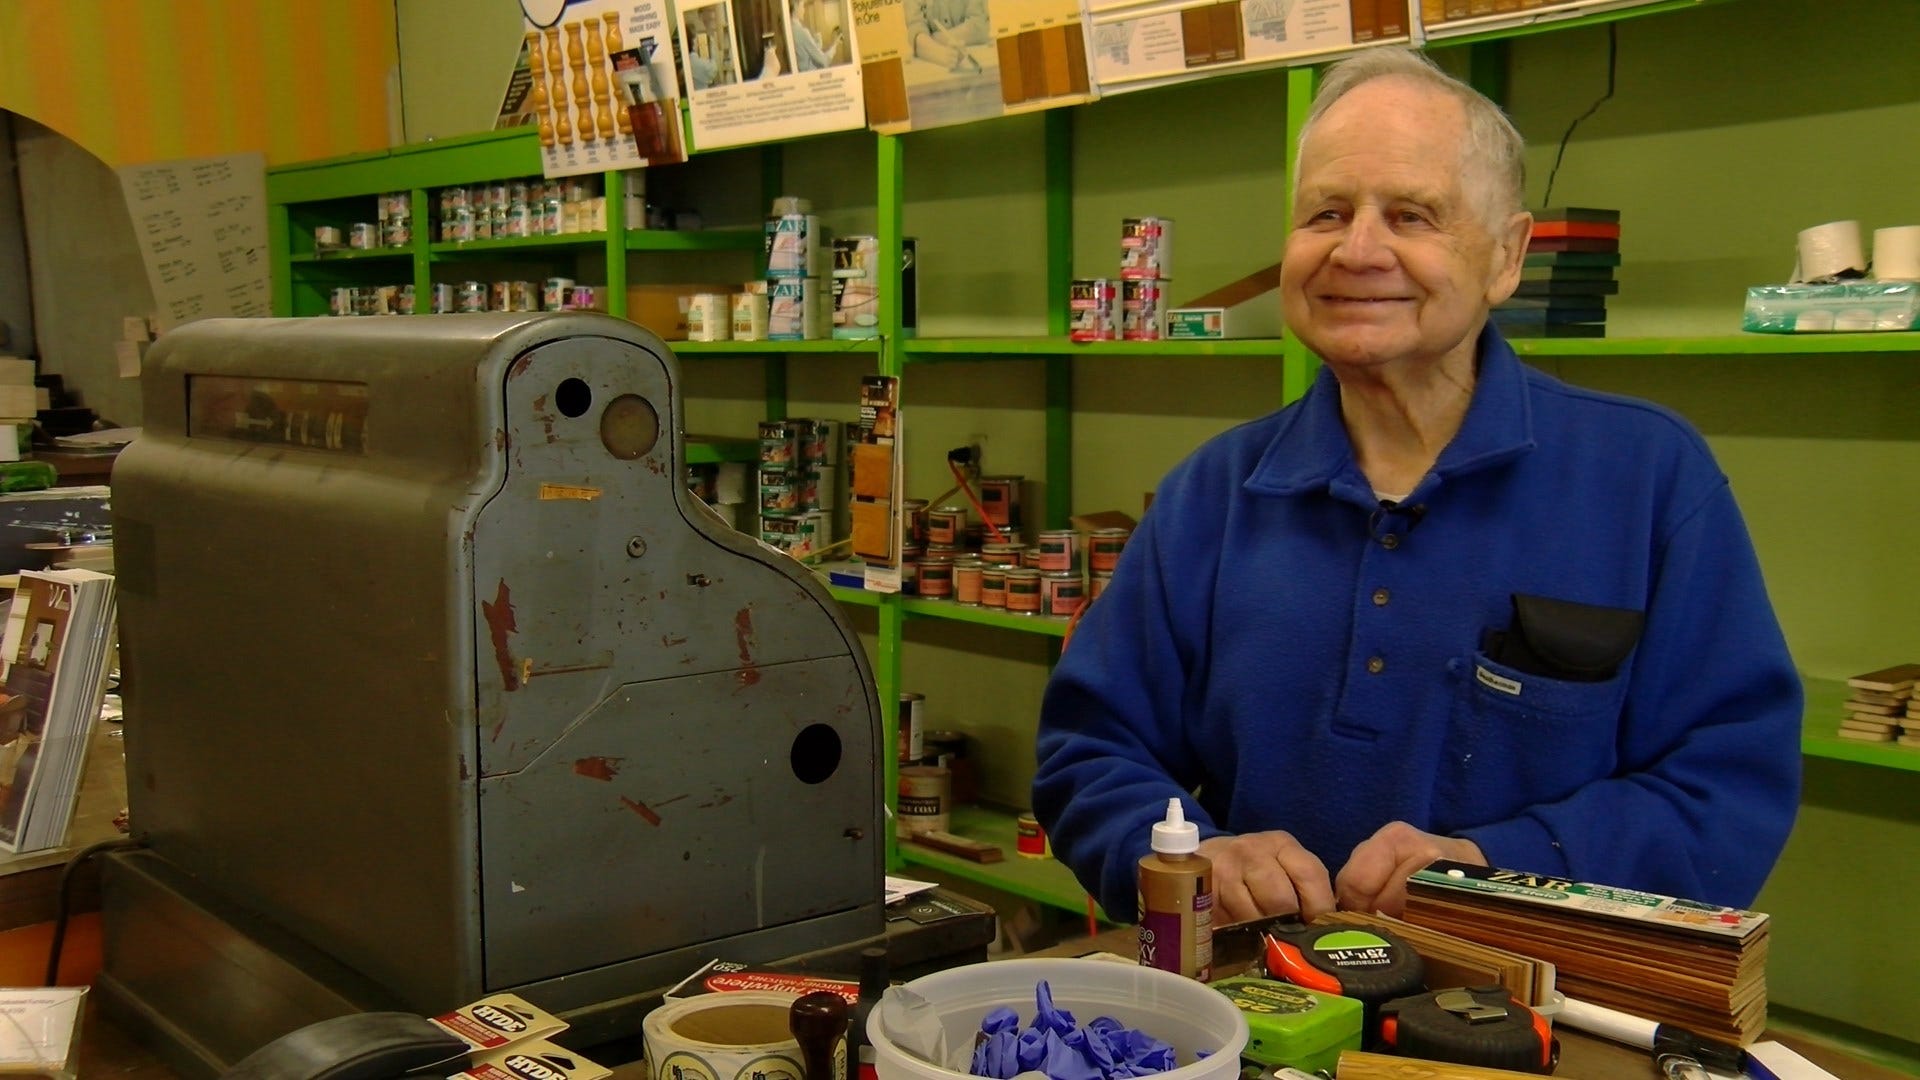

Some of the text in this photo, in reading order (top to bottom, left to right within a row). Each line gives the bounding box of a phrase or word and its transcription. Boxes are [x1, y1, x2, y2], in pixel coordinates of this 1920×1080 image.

[863, 12, 880, 25] One
[1487, 870, 1573, 894] ZAR
[712, 964, 747, 974] 250
[1336, 958, 1391, 967] PITTSBURGH
[712, 977, 806, 994] Anywhere
[472, 1005, 527, 1033] HYDE
[505, 1055, 564, 1080] HYDE
